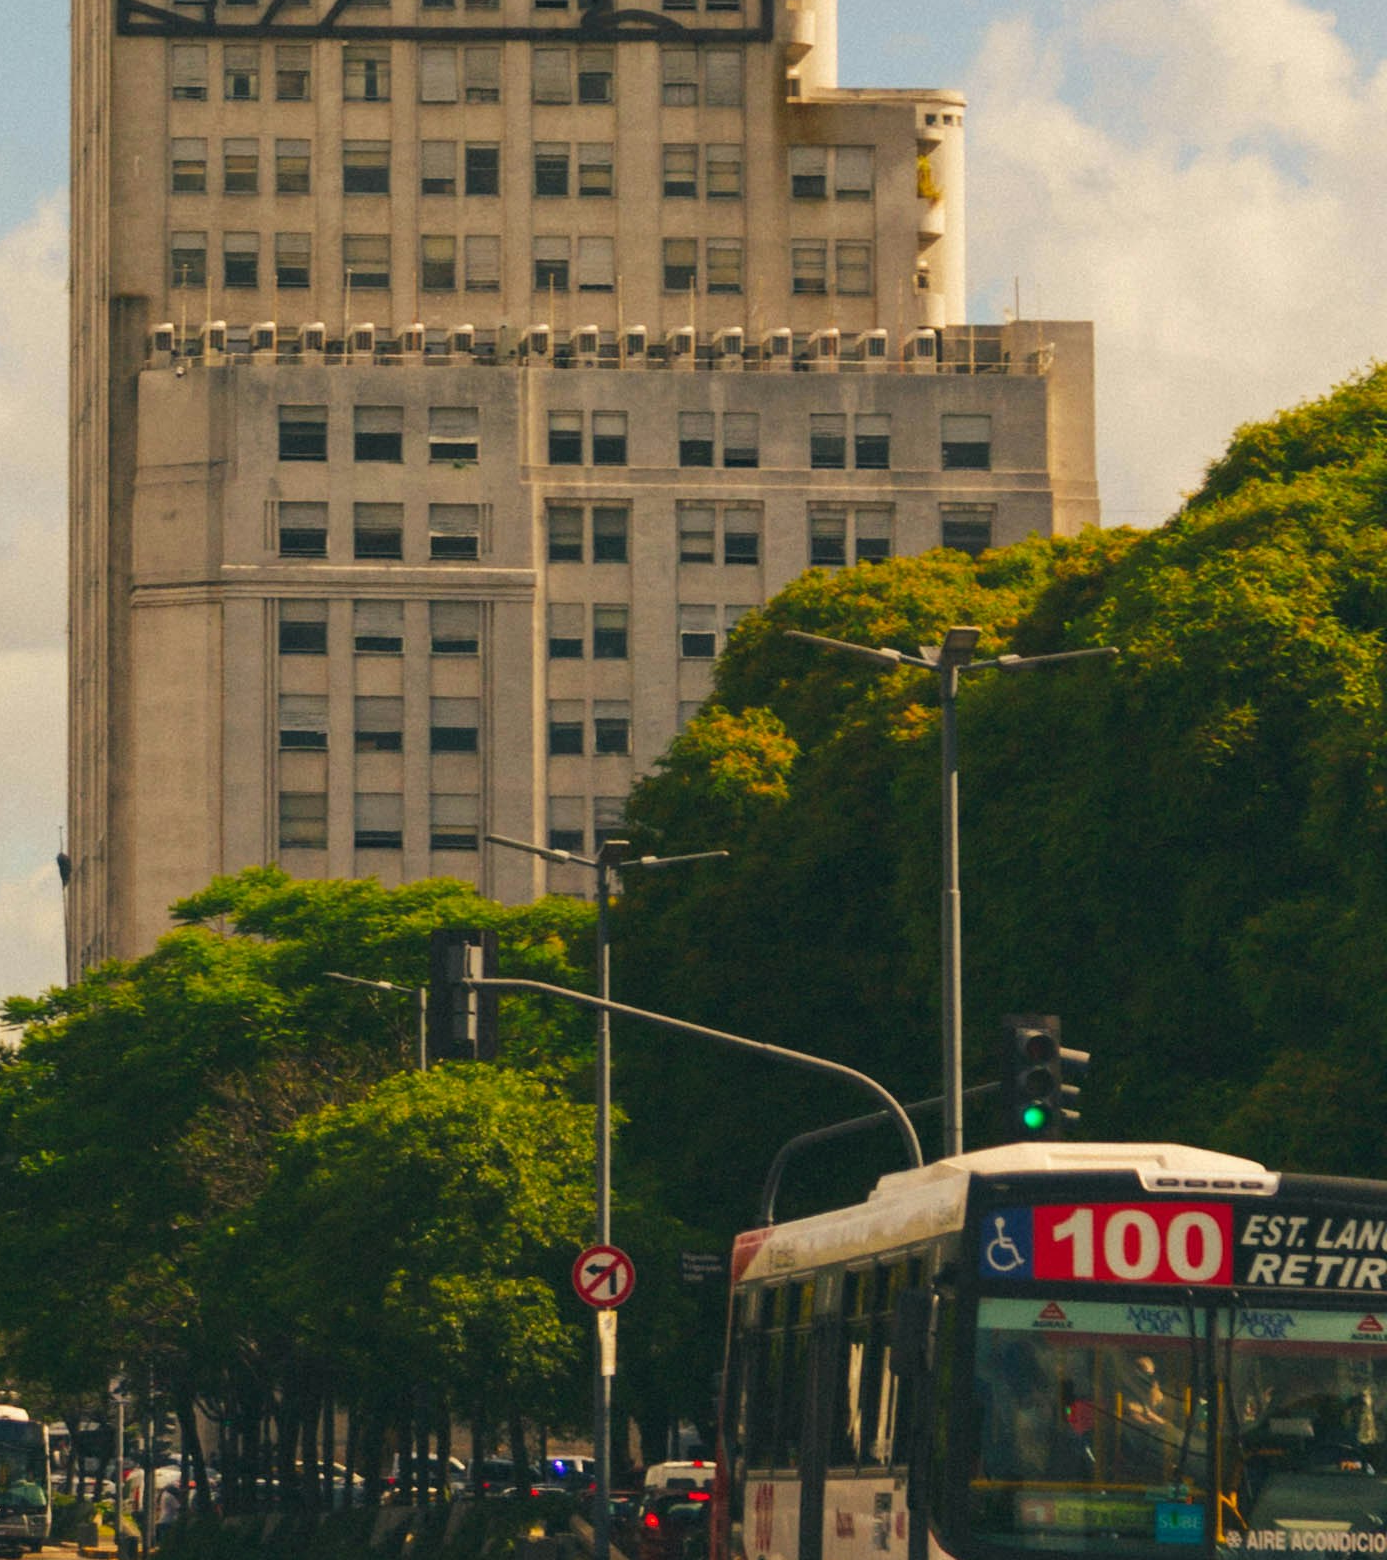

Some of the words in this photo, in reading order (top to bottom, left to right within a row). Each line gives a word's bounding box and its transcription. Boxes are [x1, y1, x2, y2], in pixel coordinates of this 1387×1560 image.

[1053, 1208, 1223, 1281] 100
[1240, 1215, 1308, 1248] EST.
[1247, 1253, 1387, 1289] RETIR
[1246, 1530, 1286, 1551] AIRE
[1290, 1531, 1387, 1553] ACONDICIO
